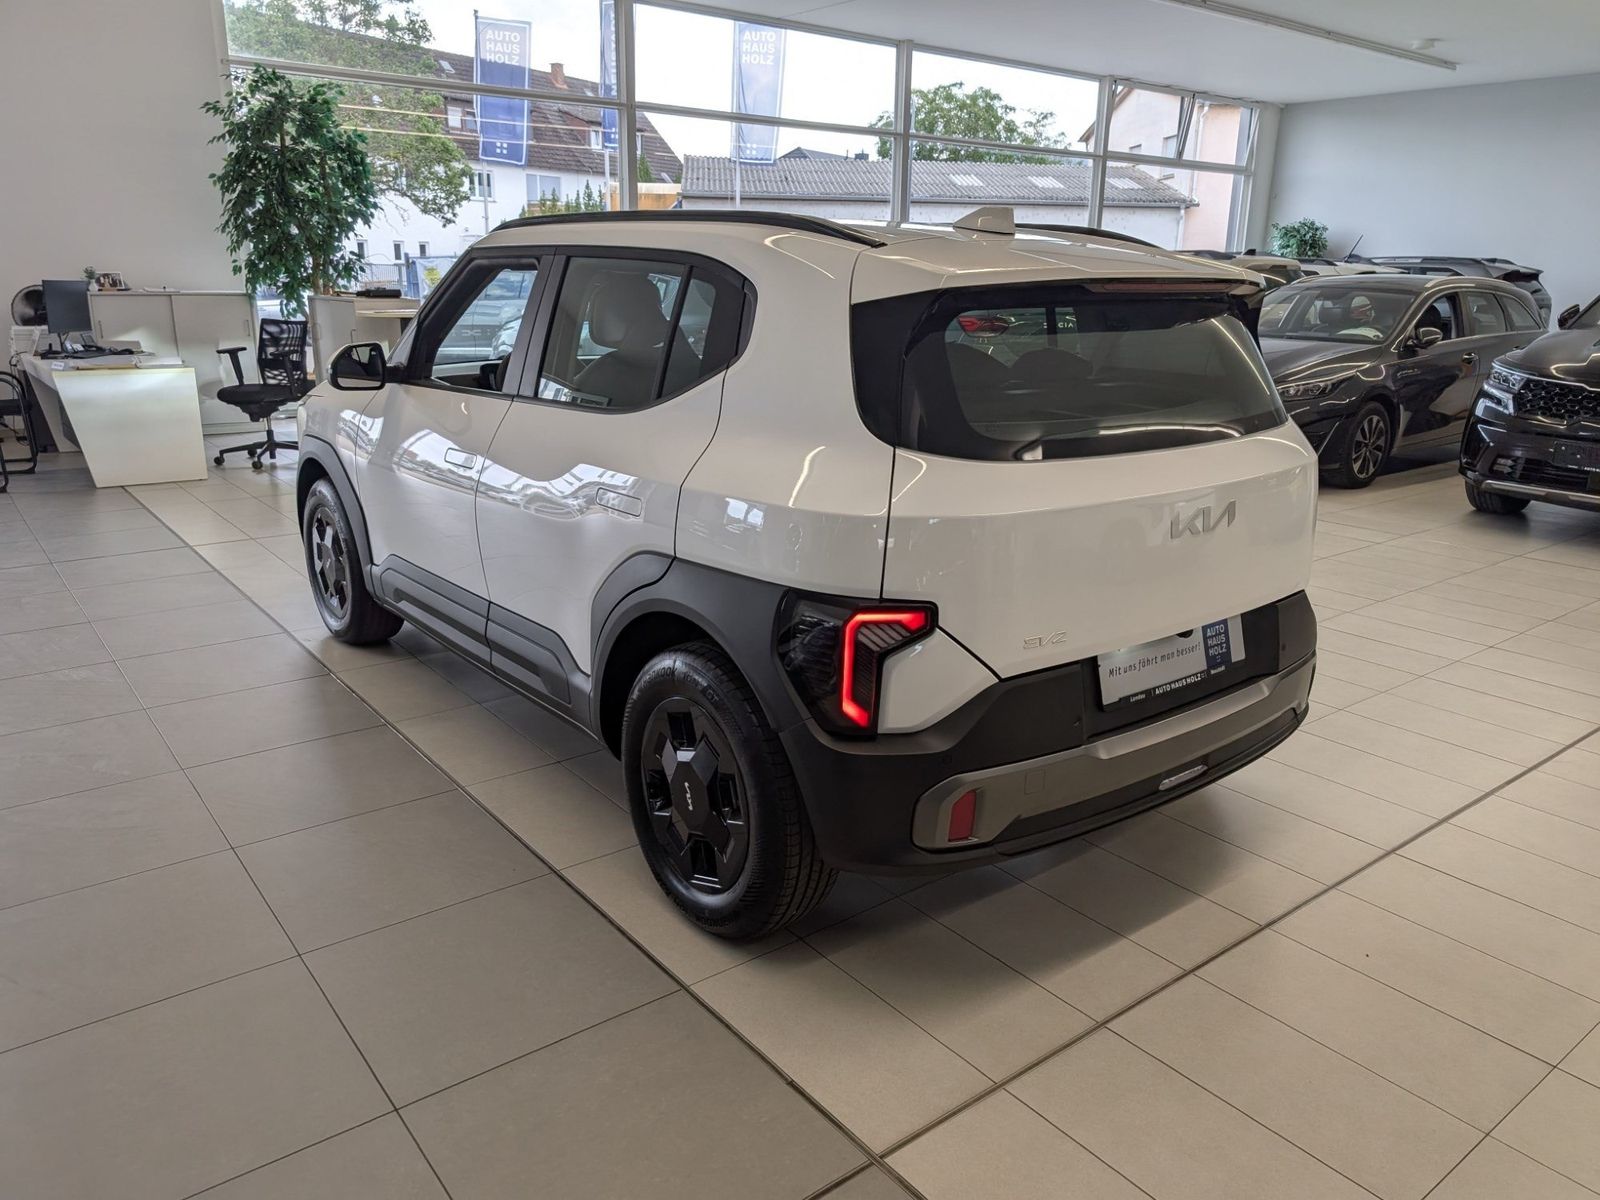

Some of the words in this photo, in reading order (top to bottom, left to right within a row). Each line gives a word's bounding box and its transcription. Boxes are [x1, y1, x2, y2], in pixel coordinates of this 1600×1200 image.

[486, 30, 520, 42] AUTO
[743, 30, 776, 42] AUTO
[486, 41, 520, 54] HAUS
[742, 42, 775, 54] HAUS
[486, 52, 520, 66] HOLZ
[741, 53, 774, 65] HOLZ
[1207, 623, 1225, 638] AUTO
[1023, 630, 1067, 650] EV2
[1207, 633, 1226, 648] HAUS
[1208, 643, 1228, 657] HOLZ
[1109, 665, 1122, 679] Mit
[1124, 663, 1137, 674] uns
[1160, 651, 1175, 663] man
[1176, 641, 1201, 658] besser!
[1155, 683, 1171, 695] AUTO
[1170, 678, 1187, 690] HAUS
[1186, 673, 1202, 684] HOLZ
